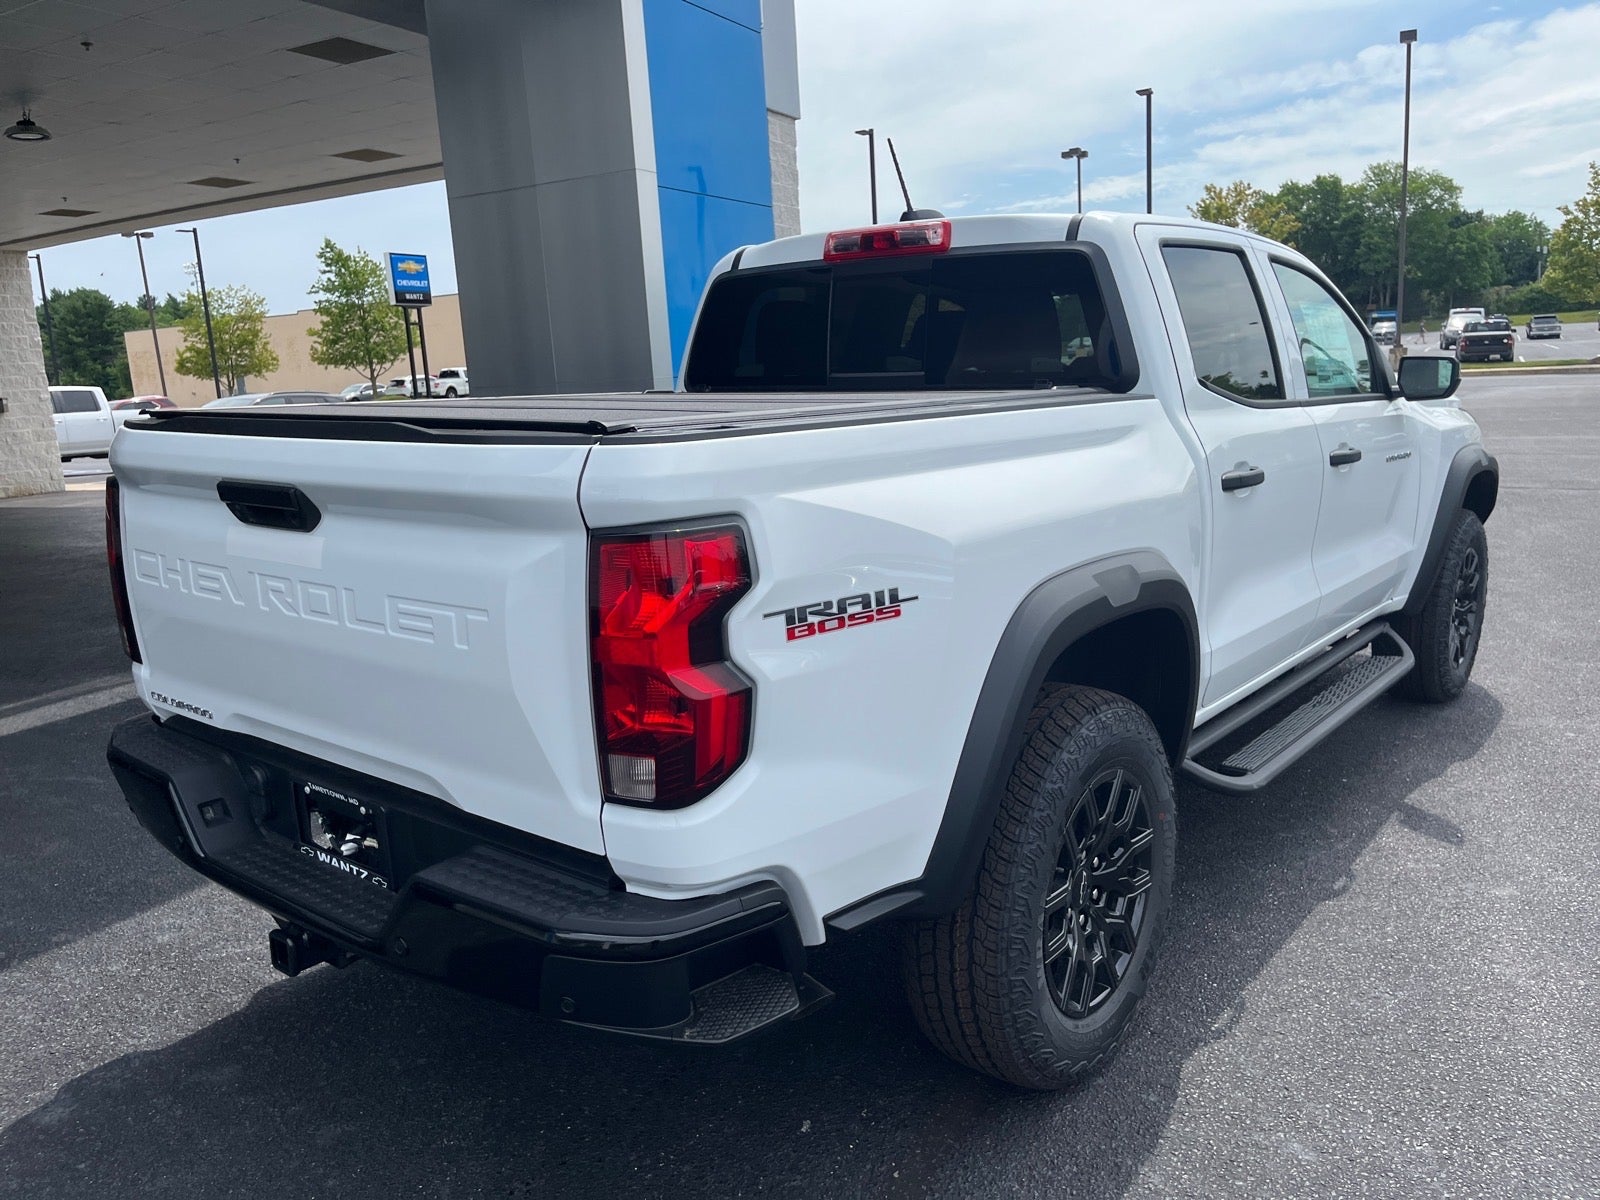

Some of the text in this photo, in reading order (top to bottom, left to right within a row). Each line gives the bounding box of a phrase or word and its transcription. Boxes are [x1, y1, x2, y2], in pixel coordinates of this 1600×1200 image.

[397, 279, 428, 287] CHEVROLET
[133, 548, 490, 650] CHEVROLET
[763, 588, 919, 626] TRAIL
[786, 604, 902, 642] BOSS
